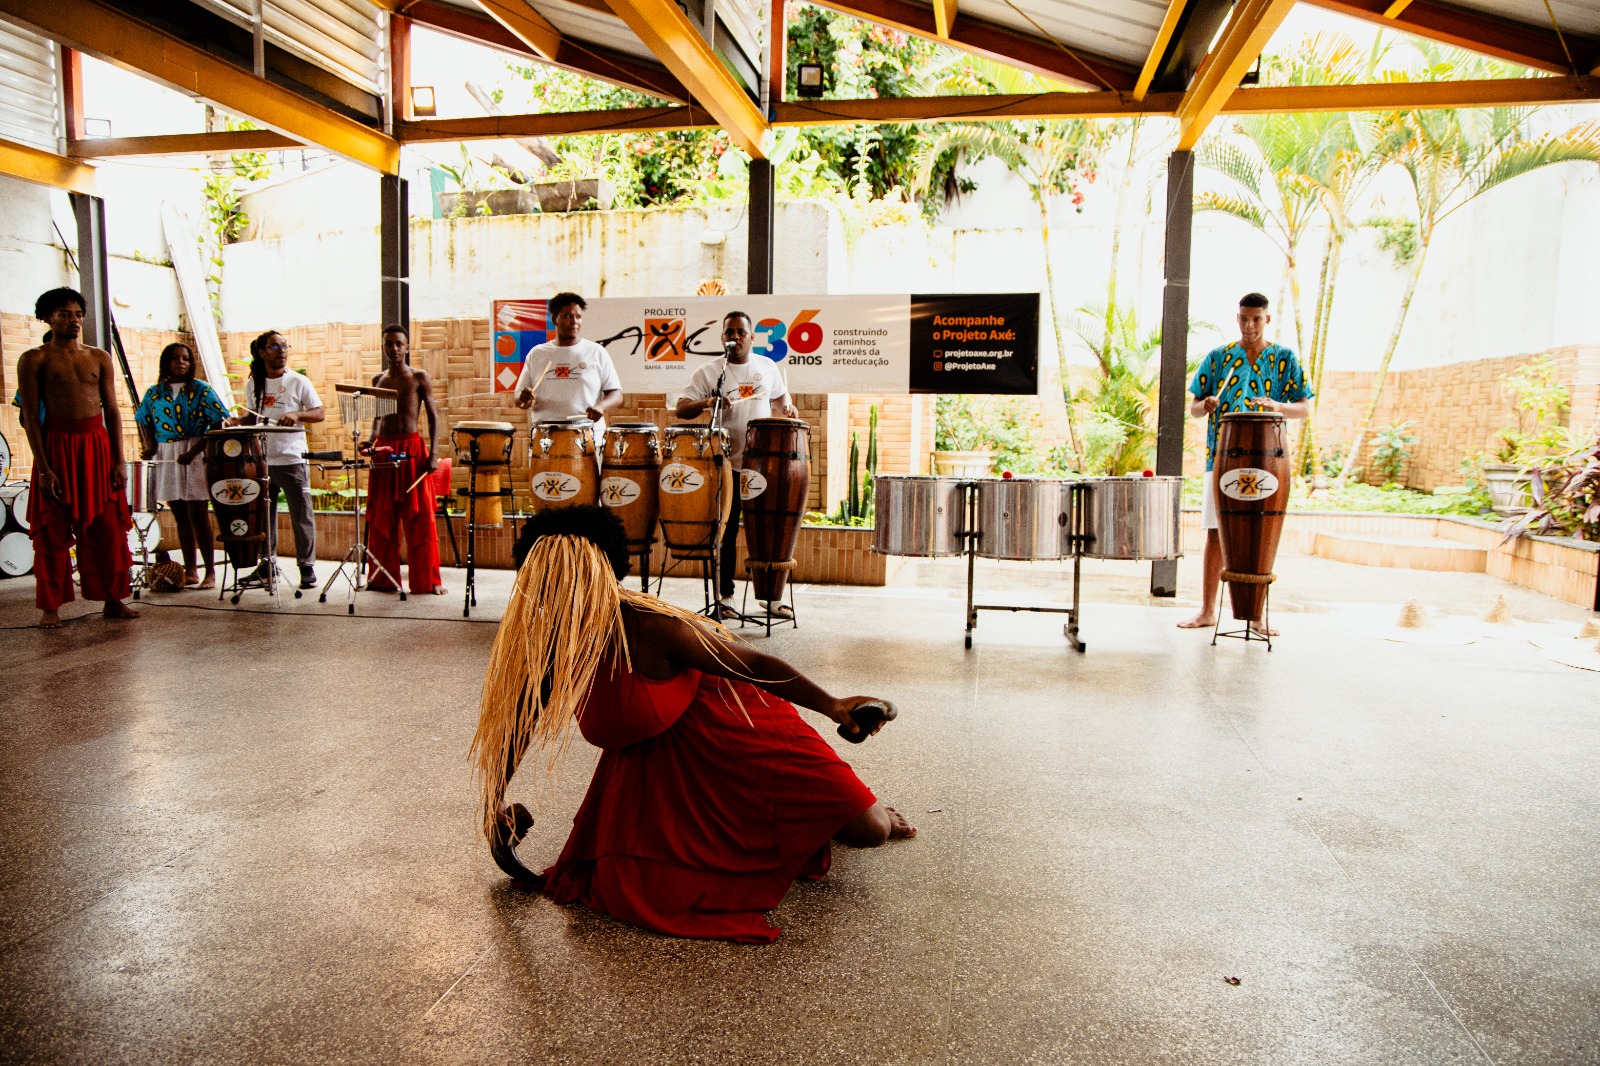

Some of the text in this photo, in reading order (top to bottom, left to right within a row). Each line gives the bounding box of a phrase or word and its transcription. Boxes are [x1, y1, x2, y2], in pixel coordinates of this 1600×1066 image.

[644, 308, 687, 316] PROJETO
[933, 315, 1005, 328] Acompanhe
[752, 309, 823, 362] 36
[833, 328, 888, 336] construindo
[933, 328, 1016, 343] o Projeto Axé:
[833, 337, 877, 346] caminhos
[832, 348, 880, 356] através da
[944, 349, 1014, 359] projetoaxe.org.br
[788, 355, 823, 366] anos
[832, 357, 890, 367] arteducação
[944, 361, 997, 372] @ProjetoAxe
